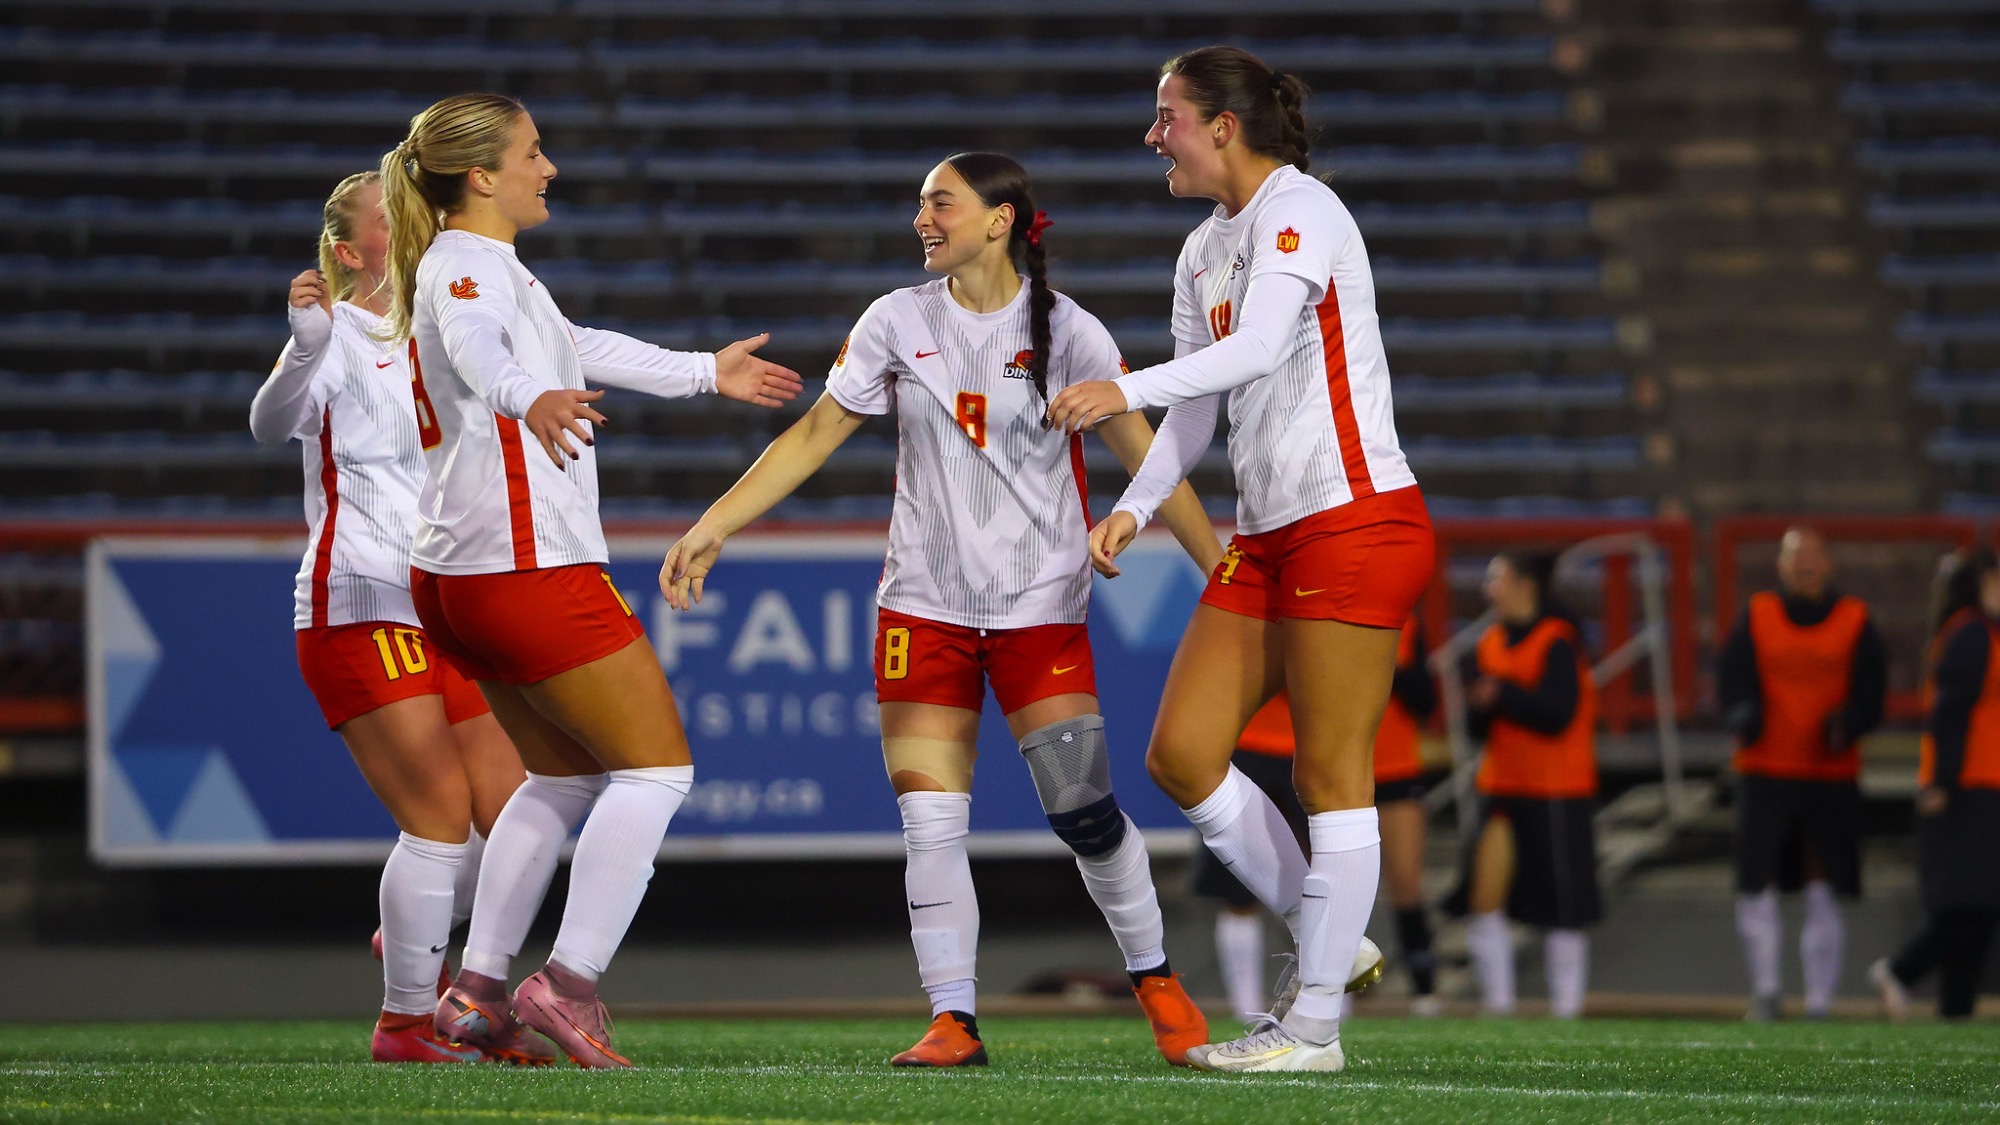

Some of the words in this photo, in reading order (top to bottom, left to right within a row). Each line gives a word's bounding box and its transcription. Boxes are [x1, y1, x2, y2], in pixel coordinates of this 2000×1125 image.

[1278, 234, 1298, 250] CW
[955, 390, 988, 449] 8
[371, 627, 428, 681] 10
[884, 626, 911, 680] 8
